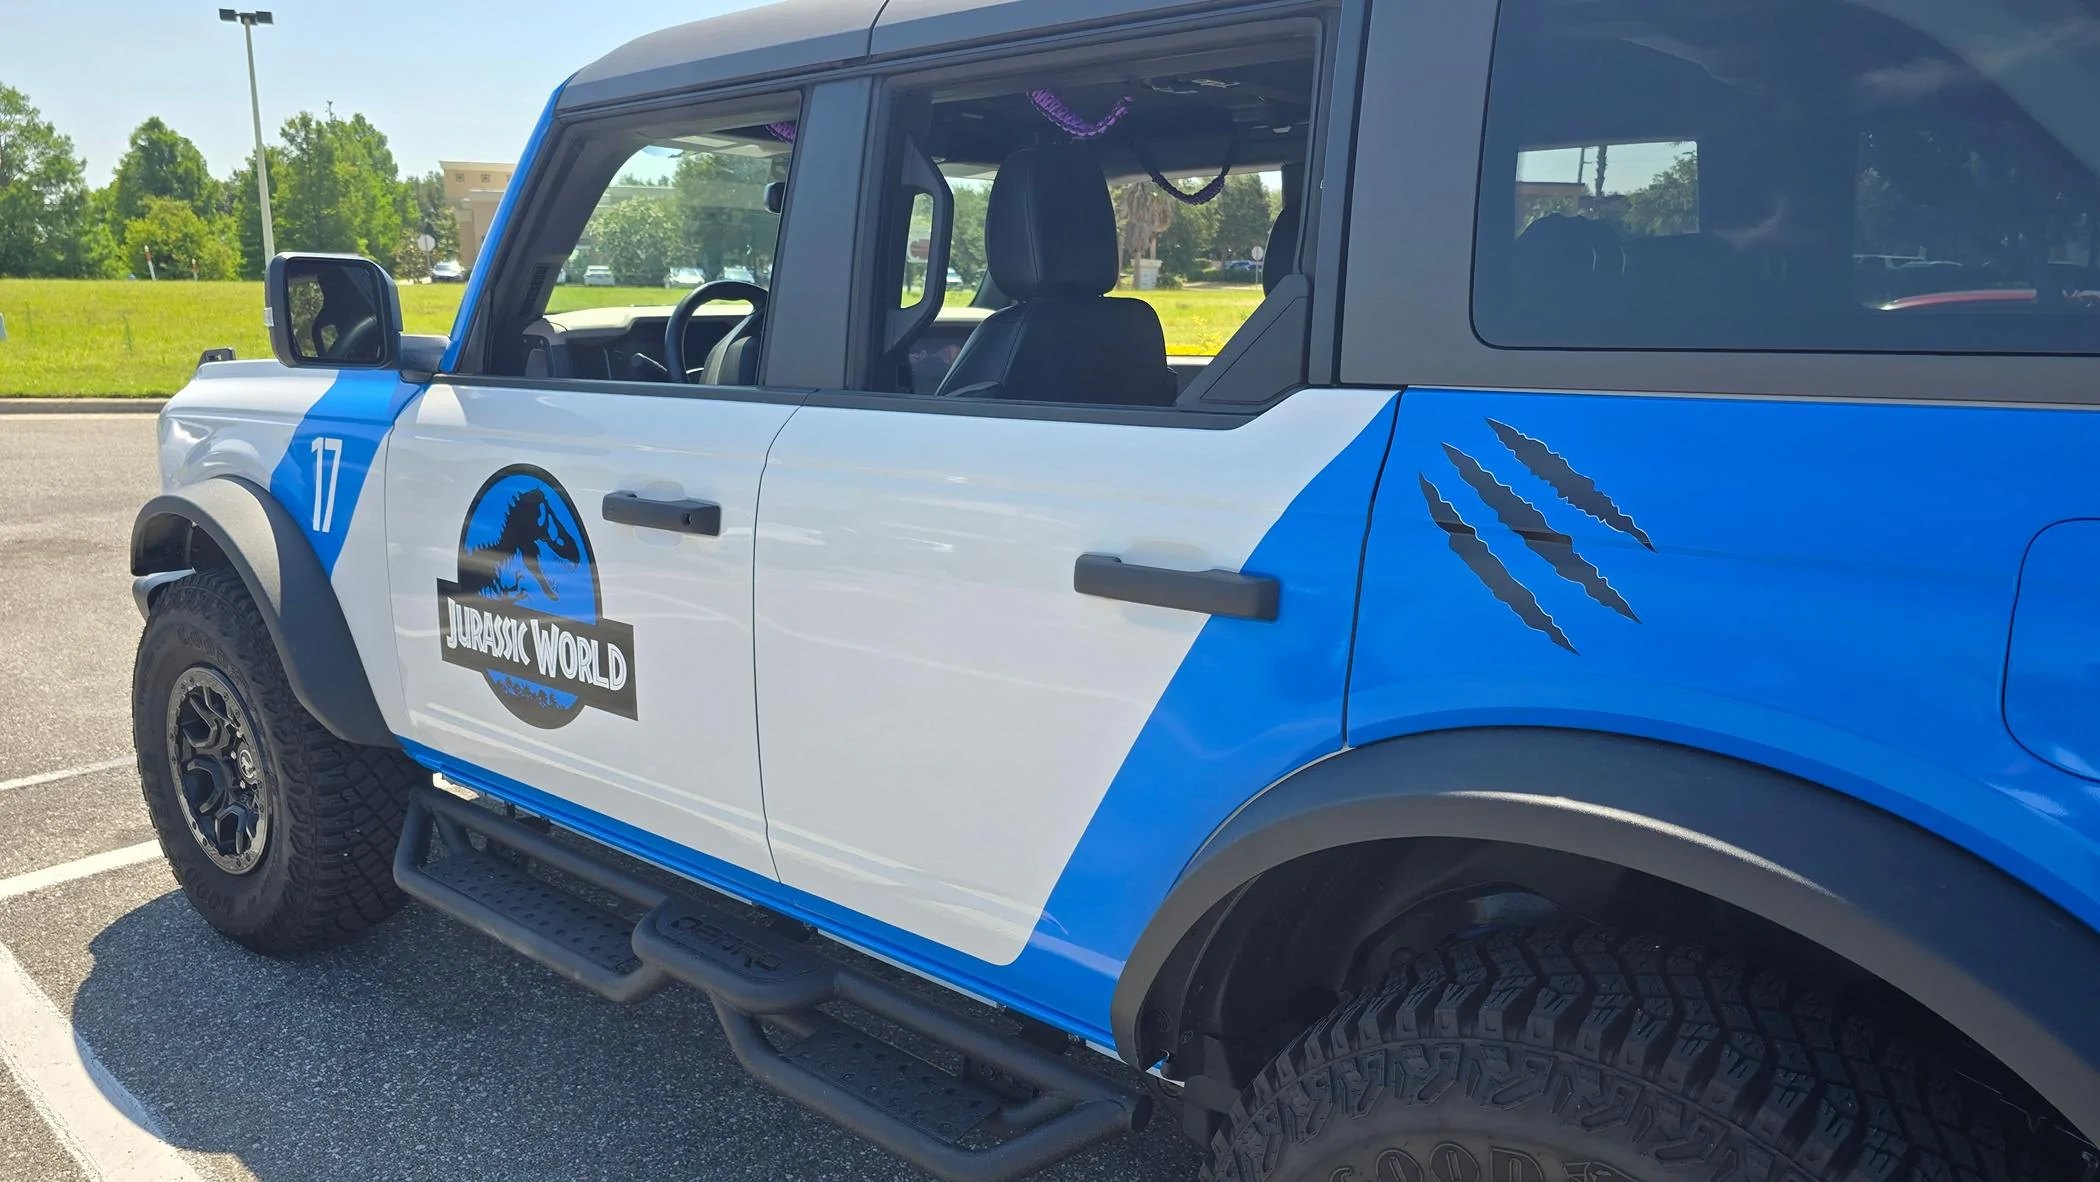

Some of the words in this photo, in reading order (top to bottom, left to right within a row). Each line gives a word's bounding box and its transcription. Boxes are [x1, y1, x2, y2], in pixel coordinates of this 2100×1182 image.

[311, 436, 343, 533] 17
[446, 597, 531, 666] JURASSIC
[530, 619, 627, 691] WORLD
